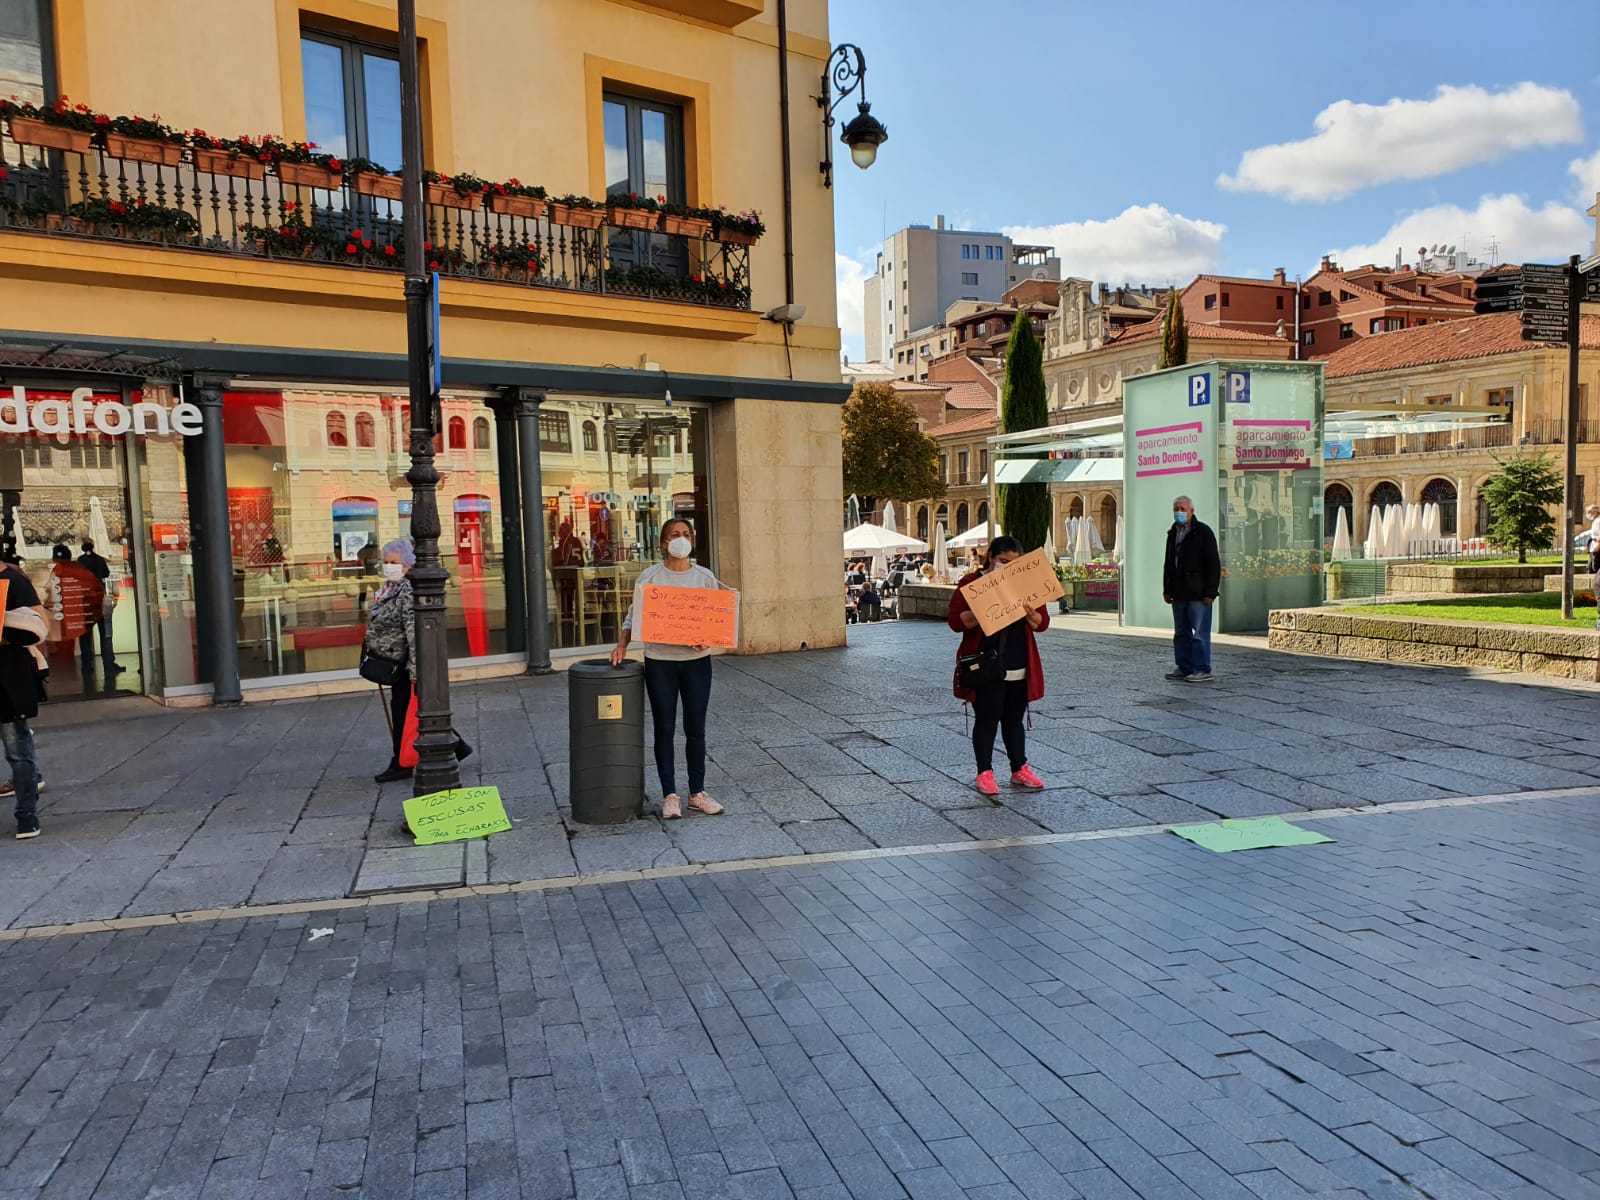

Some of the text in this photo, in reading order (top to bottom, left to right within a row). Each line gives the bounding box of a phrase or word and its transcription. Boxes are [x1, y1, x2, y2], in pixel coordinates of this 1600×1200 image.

[1192, 375, 1206, 405] P
[1231, 373, 1245, 401] P
[0, 386, 203, 436] dafone
[1138, 433, 1198, 451] aparcamiento
[1236, 431, 1306, 444] aparcamiento
[1138, 450, 1197, 467] Santo Domingo
[1236, 446, 1305, 461] Santo Domingo
[464, 789, 490, 800] SON
[417, 802, 486, 826] ESCUSAS
